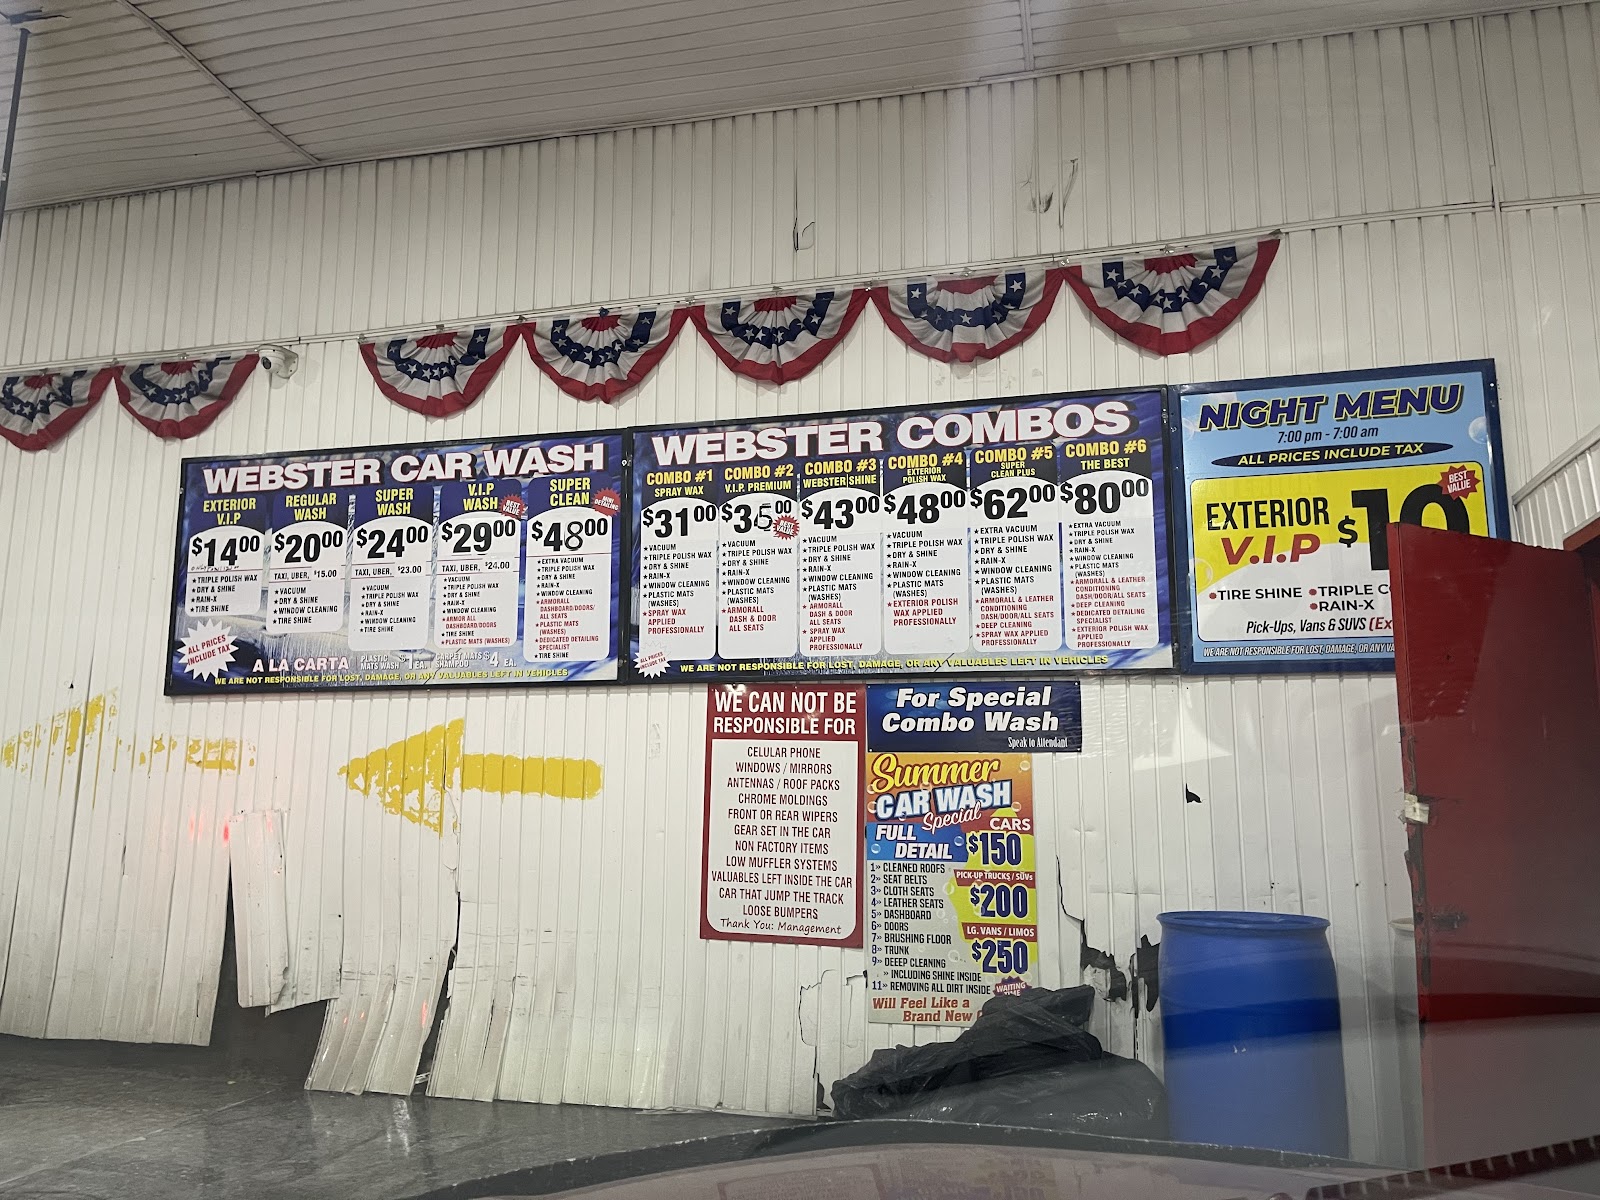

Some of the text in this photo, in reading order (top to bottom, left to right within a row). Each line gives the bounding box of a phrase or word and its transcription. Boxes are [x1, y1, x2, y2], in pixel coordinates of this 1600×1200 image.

[1199, 384, 1464, 431] NIGHT MENU
[652, 401, 1131, 466] WEBSTER COMBOS
[1277, 430, 1302, 443] 7:00
[1304, 432, 1322, 443] pm
[1333, 426, 1358, 439] 7:00
[1360, 427, 1379, 438] am
[975, 446, 1053, 464] COMBO #5
[1065, 439, 1147, 457] COMBO #6
[1238, 443, 1424, 466] ALL PRICES INCLUDE TAX
[805, 458, 877, 475] COMBO #3
[888, 452, 963, 469] COMBO #4
[1001, 461, 1025, 469] SUPER
[1081, 458, 1130, 470] THE BEST
[203, 443, 604, 494] WEBSTER CAR WASH
[724, 464, 794, 480] COMBO #2
[907, 467, 942, 475] EXTERIOR
[991, 468, 1036, 478] CLEAN PLUS
[647, 469, 713, 485] COMBO #1
[903, 474, 946, 484] POLISH WAX
[1448, 471, 1467, 483] BEST
[468, 483, 495, 496] V.I.P
[550, 478, 591, 492] SUPER
[655, 486, 704, 497] SPRAY WAX
[725, 481, 791, 493] V.I.P. PREMIUM
[1447, 479, 1471, 493] VALUE
[285, 493, 337, 507] REGULAR
[375, 488, 414, 502] SUPER
[550, 492, 590, 507] CLEAN
[203, 498, 256, 512] EXTERIOR
[377, 502, 410, 515] WASH
[463, 497, 498, 511] WASH
[217, 513, 241, 525] V.I.P
[294, 508, 327, 521] WASH
[1206, 497, 1329, 531] EXTERIOR
[1220, 533, 1321, 565] V.I.P
[198, 576, 218, 584] TRIPLE
[244, 574, 258, 582] WAX
[314, 570, 337, 578] $15.00
[1218, 587, 1303, 600] TIRE SHINE
[1318, 585, 1373, 596] TRIPLE
[893, 598, 958, 608] EXTERIOR POLISH
[1319, 599, 1374, 612] RAIN-X
[912, 608, 943, 616] APPLIED
[893, 617, 957, 626] PROFESSIONALLY
[1247, 618, 1366, 635] Pick-Ups, Vans & SUVS
[252, 657, 349, 672] A LA CARTA
[715, 691, 857, 713] WE CAN NOT BE
[896, 686, 1052, 711] For Special
[713, 717, 856, 734] RESPONSIBLE FOR
[882, 711, 1059, 732] Combo Wash
[1008, 737, 1068, 749] Speak to Attendant
[748, 747, 820, 758] CELULAR PHONE
[736, 762, 832, 774] WINDOWS / MIRRORS
[871, 753, 1000, 794] Summer
[727, 778, 840, 790] ANTENNAS / ROOF PACKS
[738, 793, 828, 806] CHROME MOLDINGS
[876, 779, 1012, 820] CAR WASH
[922, 802, 981, 834] Special
[990, 818, 1031, 830] CARS
[876, 825, 917, 840] FULL
[895, 843, 952, 859] DETAIL
[968, 832, 1023, 866] $150
[970, 884, 1028, 918] $200
[743, 905, 818, 919] LOOSE BUMPERS
[720, 918, 842, 935] Thank You: Management
[967, 927, 1034, 936] LG. VANS / LIMOS
[971, 939, 1028, 974] $250
[890, 981, 991, 995] REMOVING ALL DIRT INSIDE
[873, 997, 970, 1009] Will Feel Like a
[903, 1011, 941, 1022] Brand
[945, 1010, 973, 1022] New
